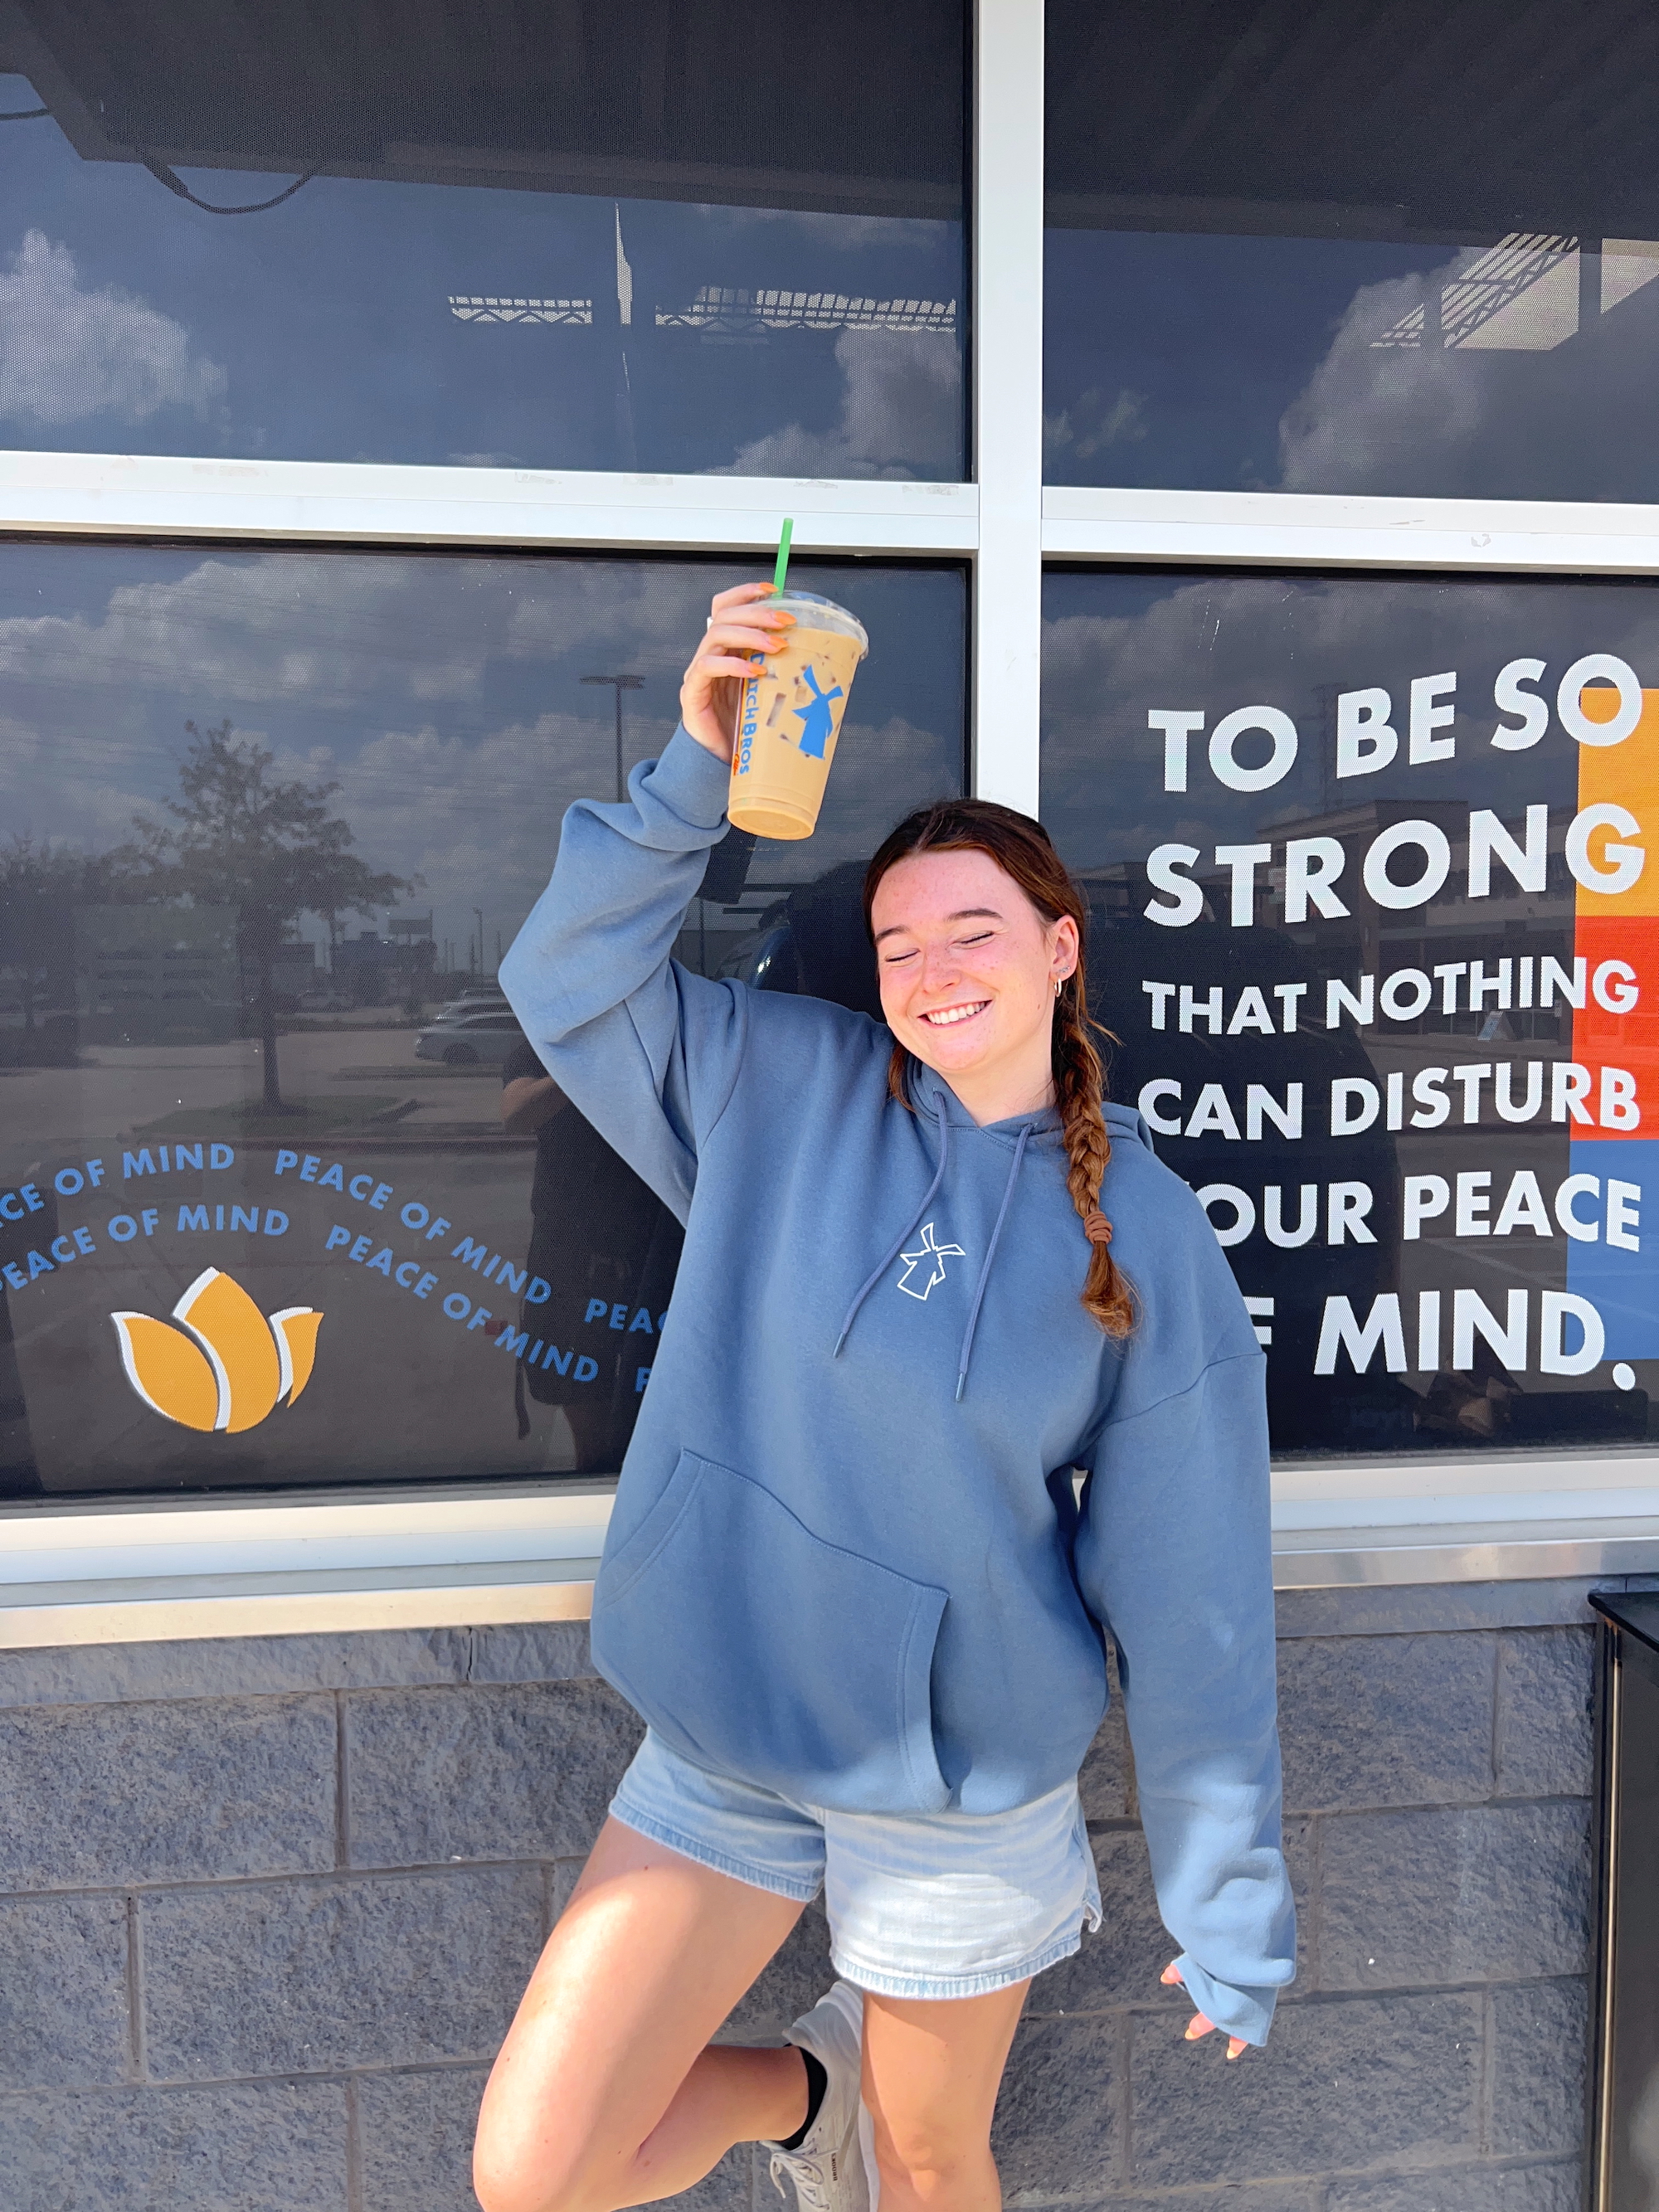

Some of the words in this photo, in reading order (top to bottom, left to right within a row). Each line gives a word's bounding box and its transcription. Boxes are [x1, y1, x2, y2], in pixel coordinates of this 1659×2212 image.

[740, 722, 757, 774] BROS
[1148, 705, 1299, 792] TO
[1336, 672, 1457, 779] BE
[1490, 654, 1643, 751] SO
[1143, 802, 1646, 927] STRONG
[1142, 980, 1307, 1034] THAT
[1326, 955, 1639, 1030] NOTHING
[1137, 1078, 1303, 1140] CAN
[1330, 1061, 1642, 1139] DISTURB
[0, 1183, 45, 1228] CE
[54, 1159, 105, 1196] OF
[123, 1143, 235, 1179] MIND
[274, 1149, 394, 1211] PEACE
[400, 1202, 451, 1242] OF
[451, 1236, 552, 1305] MIND
[1184, 1181, 1378, 1248] OUR
[1404, 1169, 1642, 1252] PEACE
[0, 1226, 97, 1291] EACE
[108, 1208, 159, 1242] OF
[177, 1203, 289, 1237] MIND
[325, 1224, 440, 1300] PEACE
[442, 1291, 493, 1332] OF
[494, 1325, 600, 1383] MIND
[1313, 1288, 1637, 1392] MIND.
